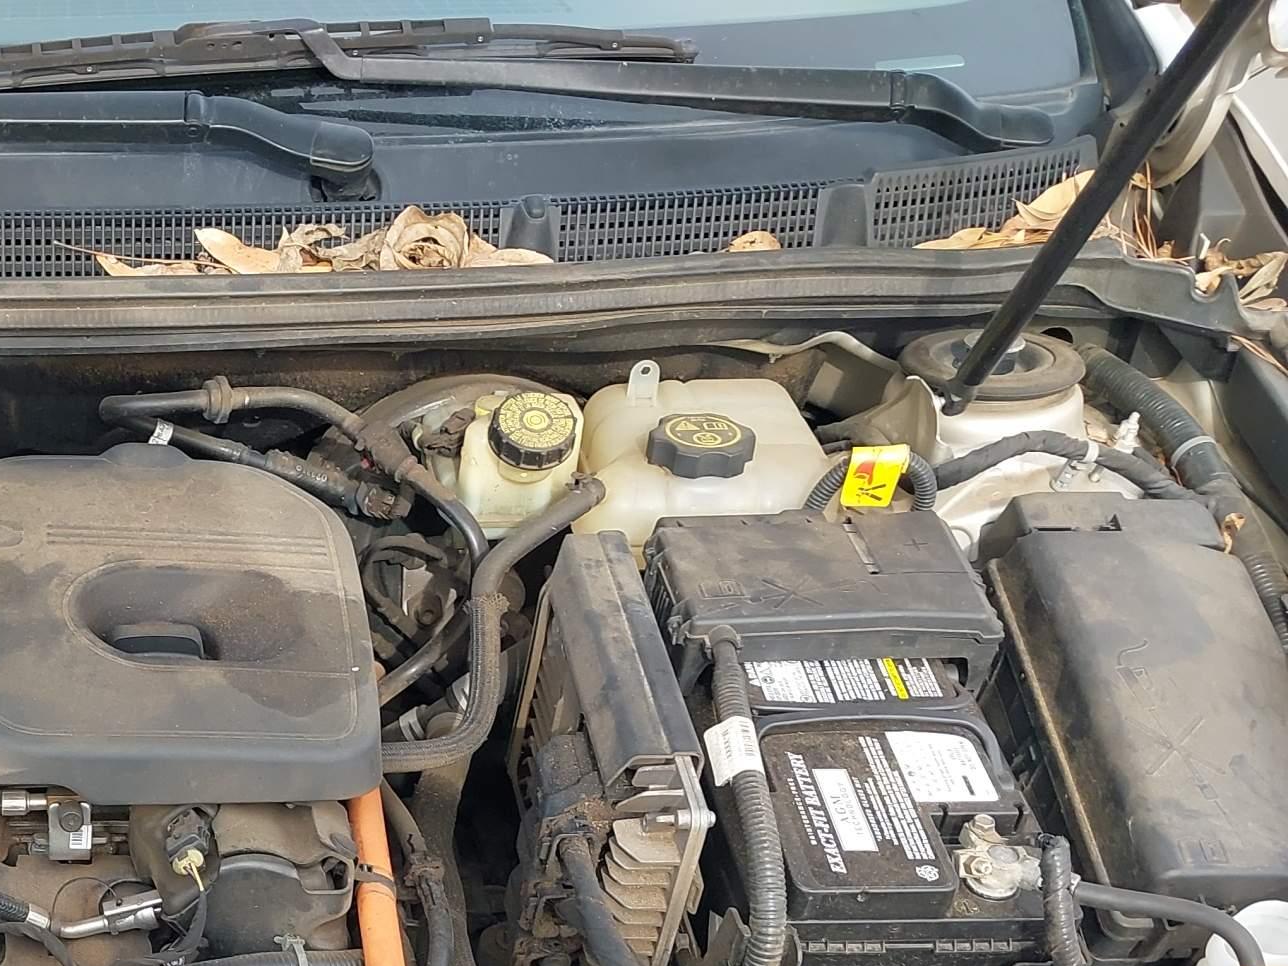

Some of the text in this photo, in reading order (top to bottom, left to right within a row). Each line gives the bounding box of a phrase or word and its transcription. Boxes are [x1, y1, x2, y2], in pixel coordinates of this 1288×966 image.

[785, 751, 848, 874] EXACT-FIT BATTERY
[830, 795, 850, 824] AGM
[838, 782, 865, 835] TECHNOLOGY
